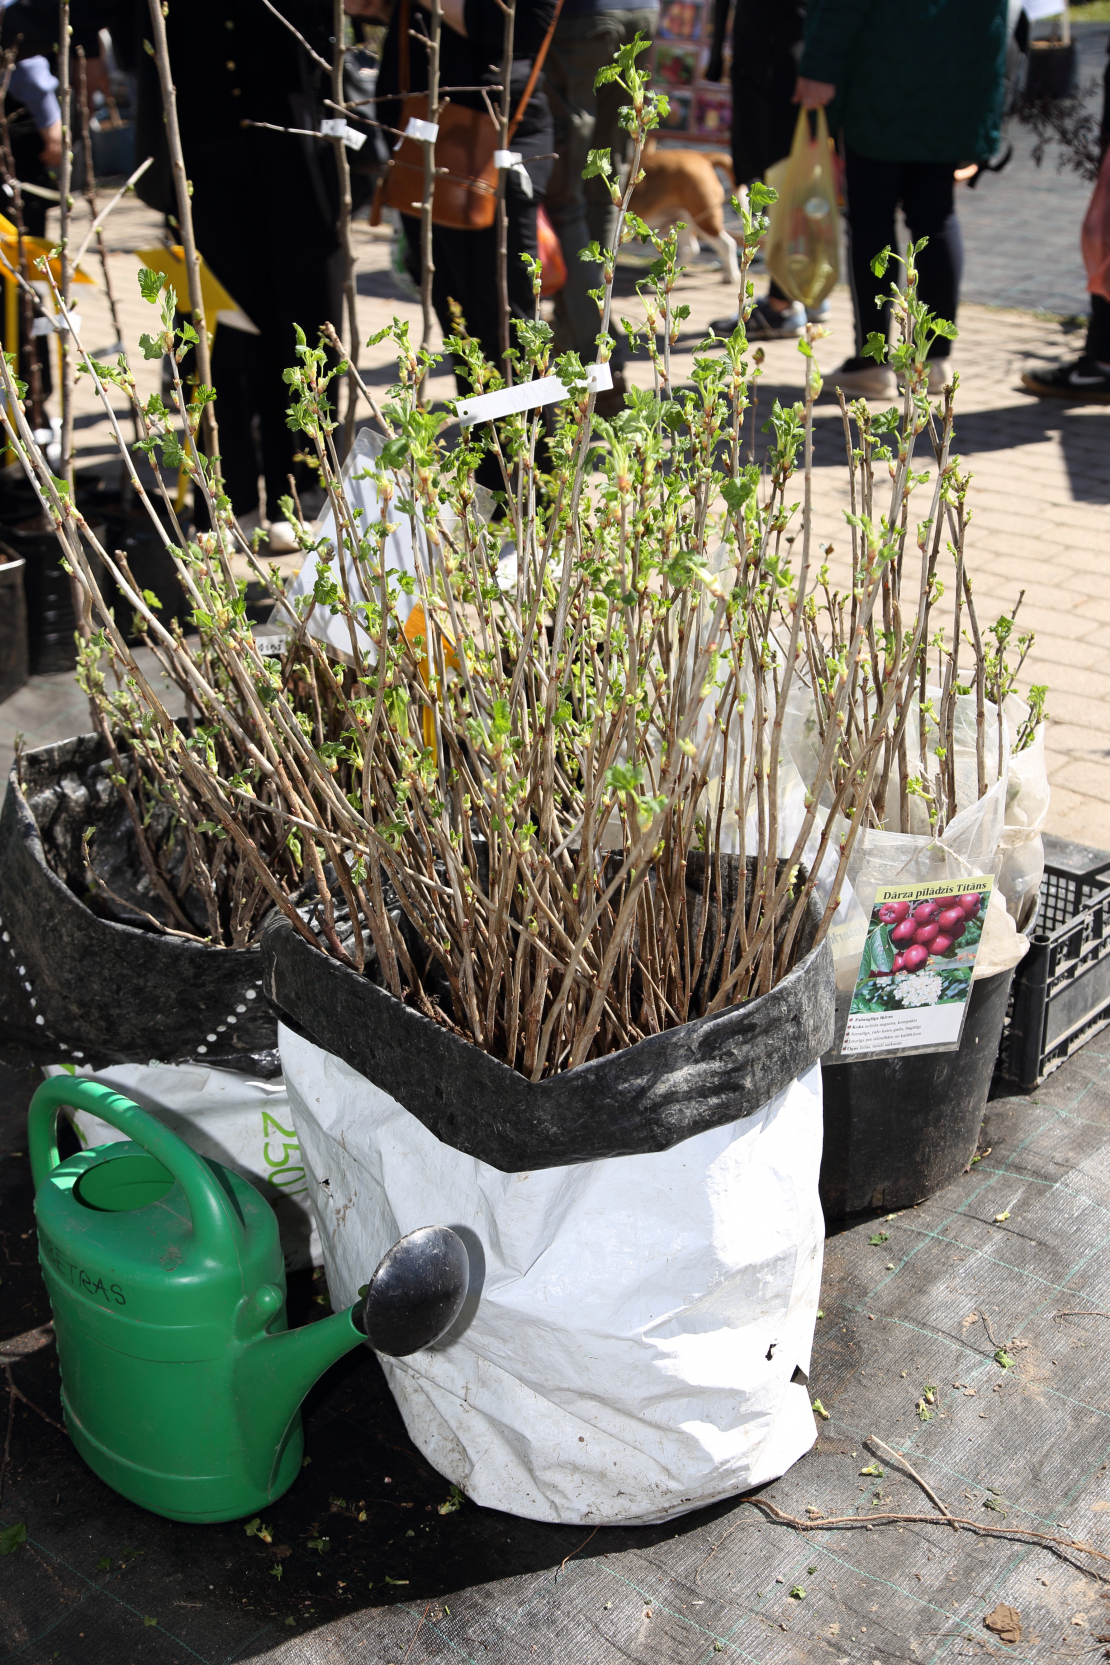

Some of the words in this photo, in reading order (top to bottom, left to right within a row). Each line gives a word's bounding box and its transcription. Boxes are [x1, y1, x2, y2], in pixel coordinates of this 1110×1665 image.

[883, 891, 913, 900] Dārza
[915, 886, 954, 899] pīlādzis
[957, 882, 988, 893] Titāns
